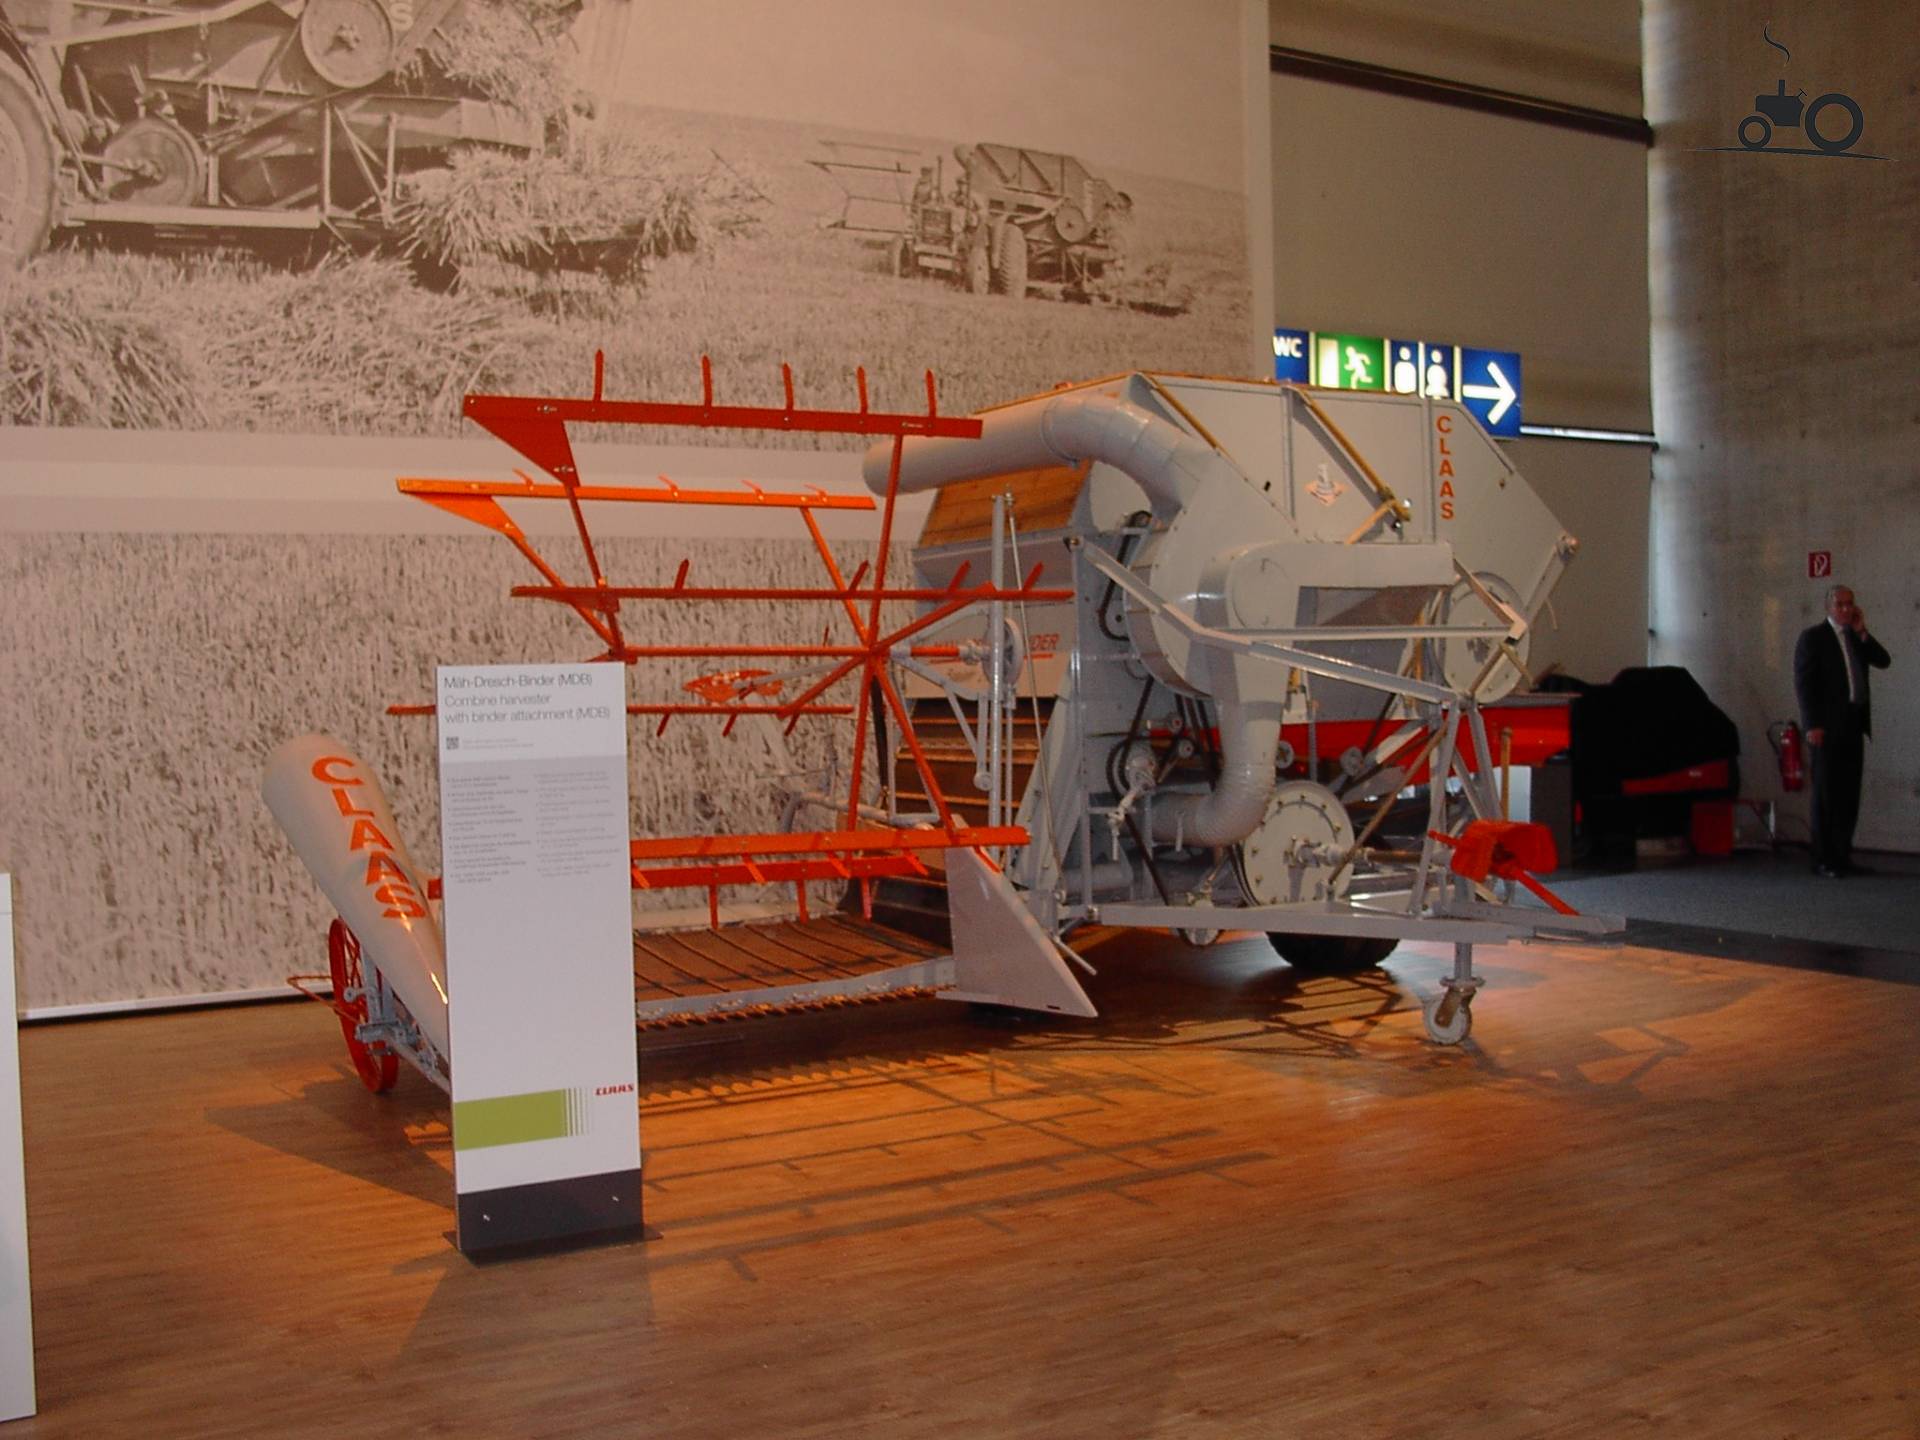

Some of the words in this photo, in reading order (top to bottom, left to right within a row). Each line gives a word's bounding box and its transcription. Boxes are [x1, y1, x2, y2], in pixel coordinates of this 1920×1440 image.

[1273, 335, 1303, 358] WC
[1436, 415, 1455, 520] CLAAS
[558, 672, 593, 688] (MDB)
[444, 694, 497, 708] Combine
[500, 693, 552, 706] harvester
[444, 711, 470, 724] with
[472, 710, 507, 722] binder
[510, 708, 573, 721] attachment
[576, 706, 611, 721] (MDB)
[311, 756, 426, 918] CLAAS
[595, 1083, 634, 1096] CLAAS
